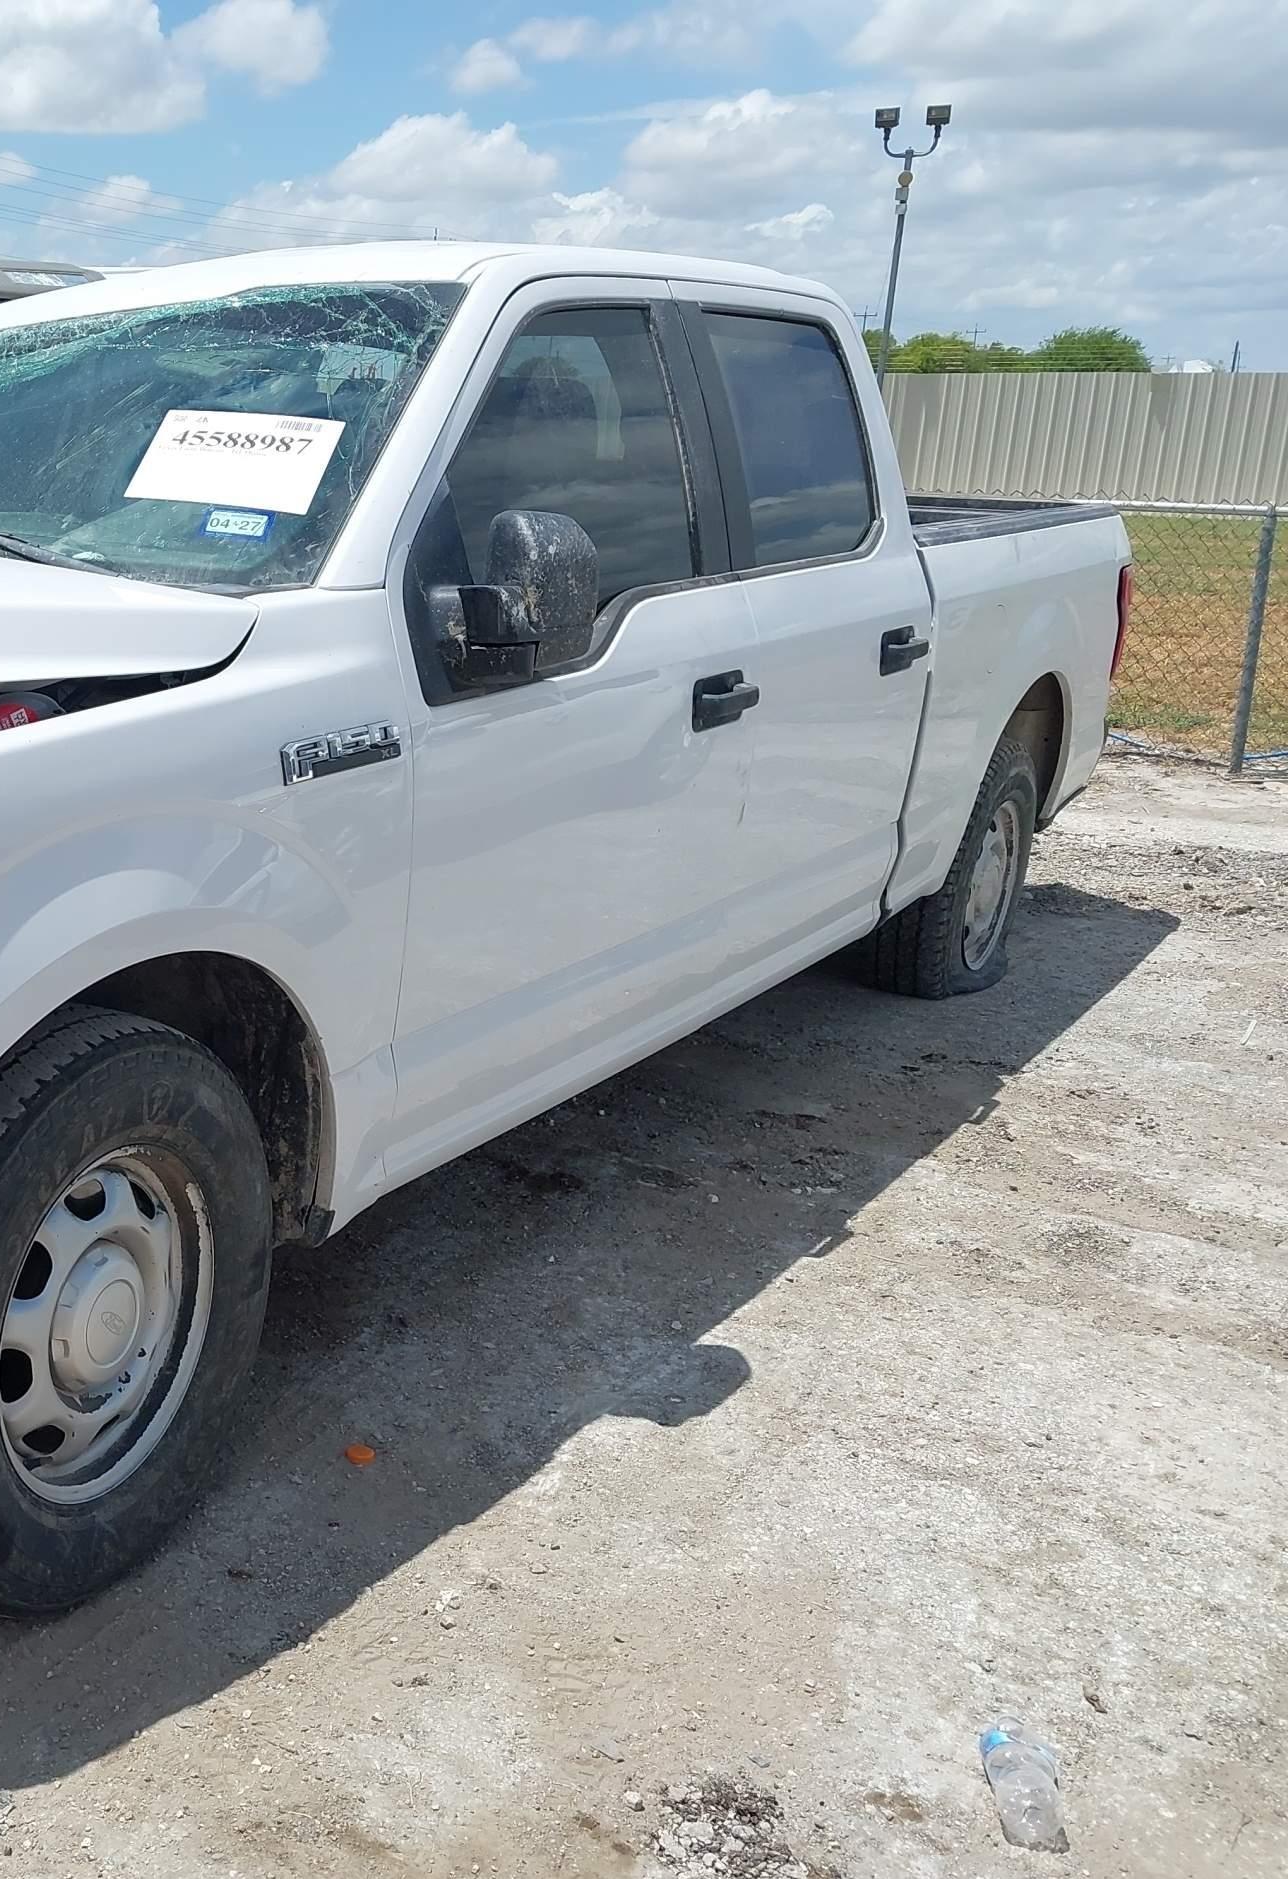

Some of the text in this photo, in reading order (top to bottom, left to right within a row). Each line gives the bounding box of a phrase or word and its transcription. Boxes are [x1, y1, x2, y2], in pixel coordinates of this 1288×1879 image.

[171, 429, 314, 455] 45588987
[209, 517, 261, 531] 04 27
[381, 747, 398, 759] XL
